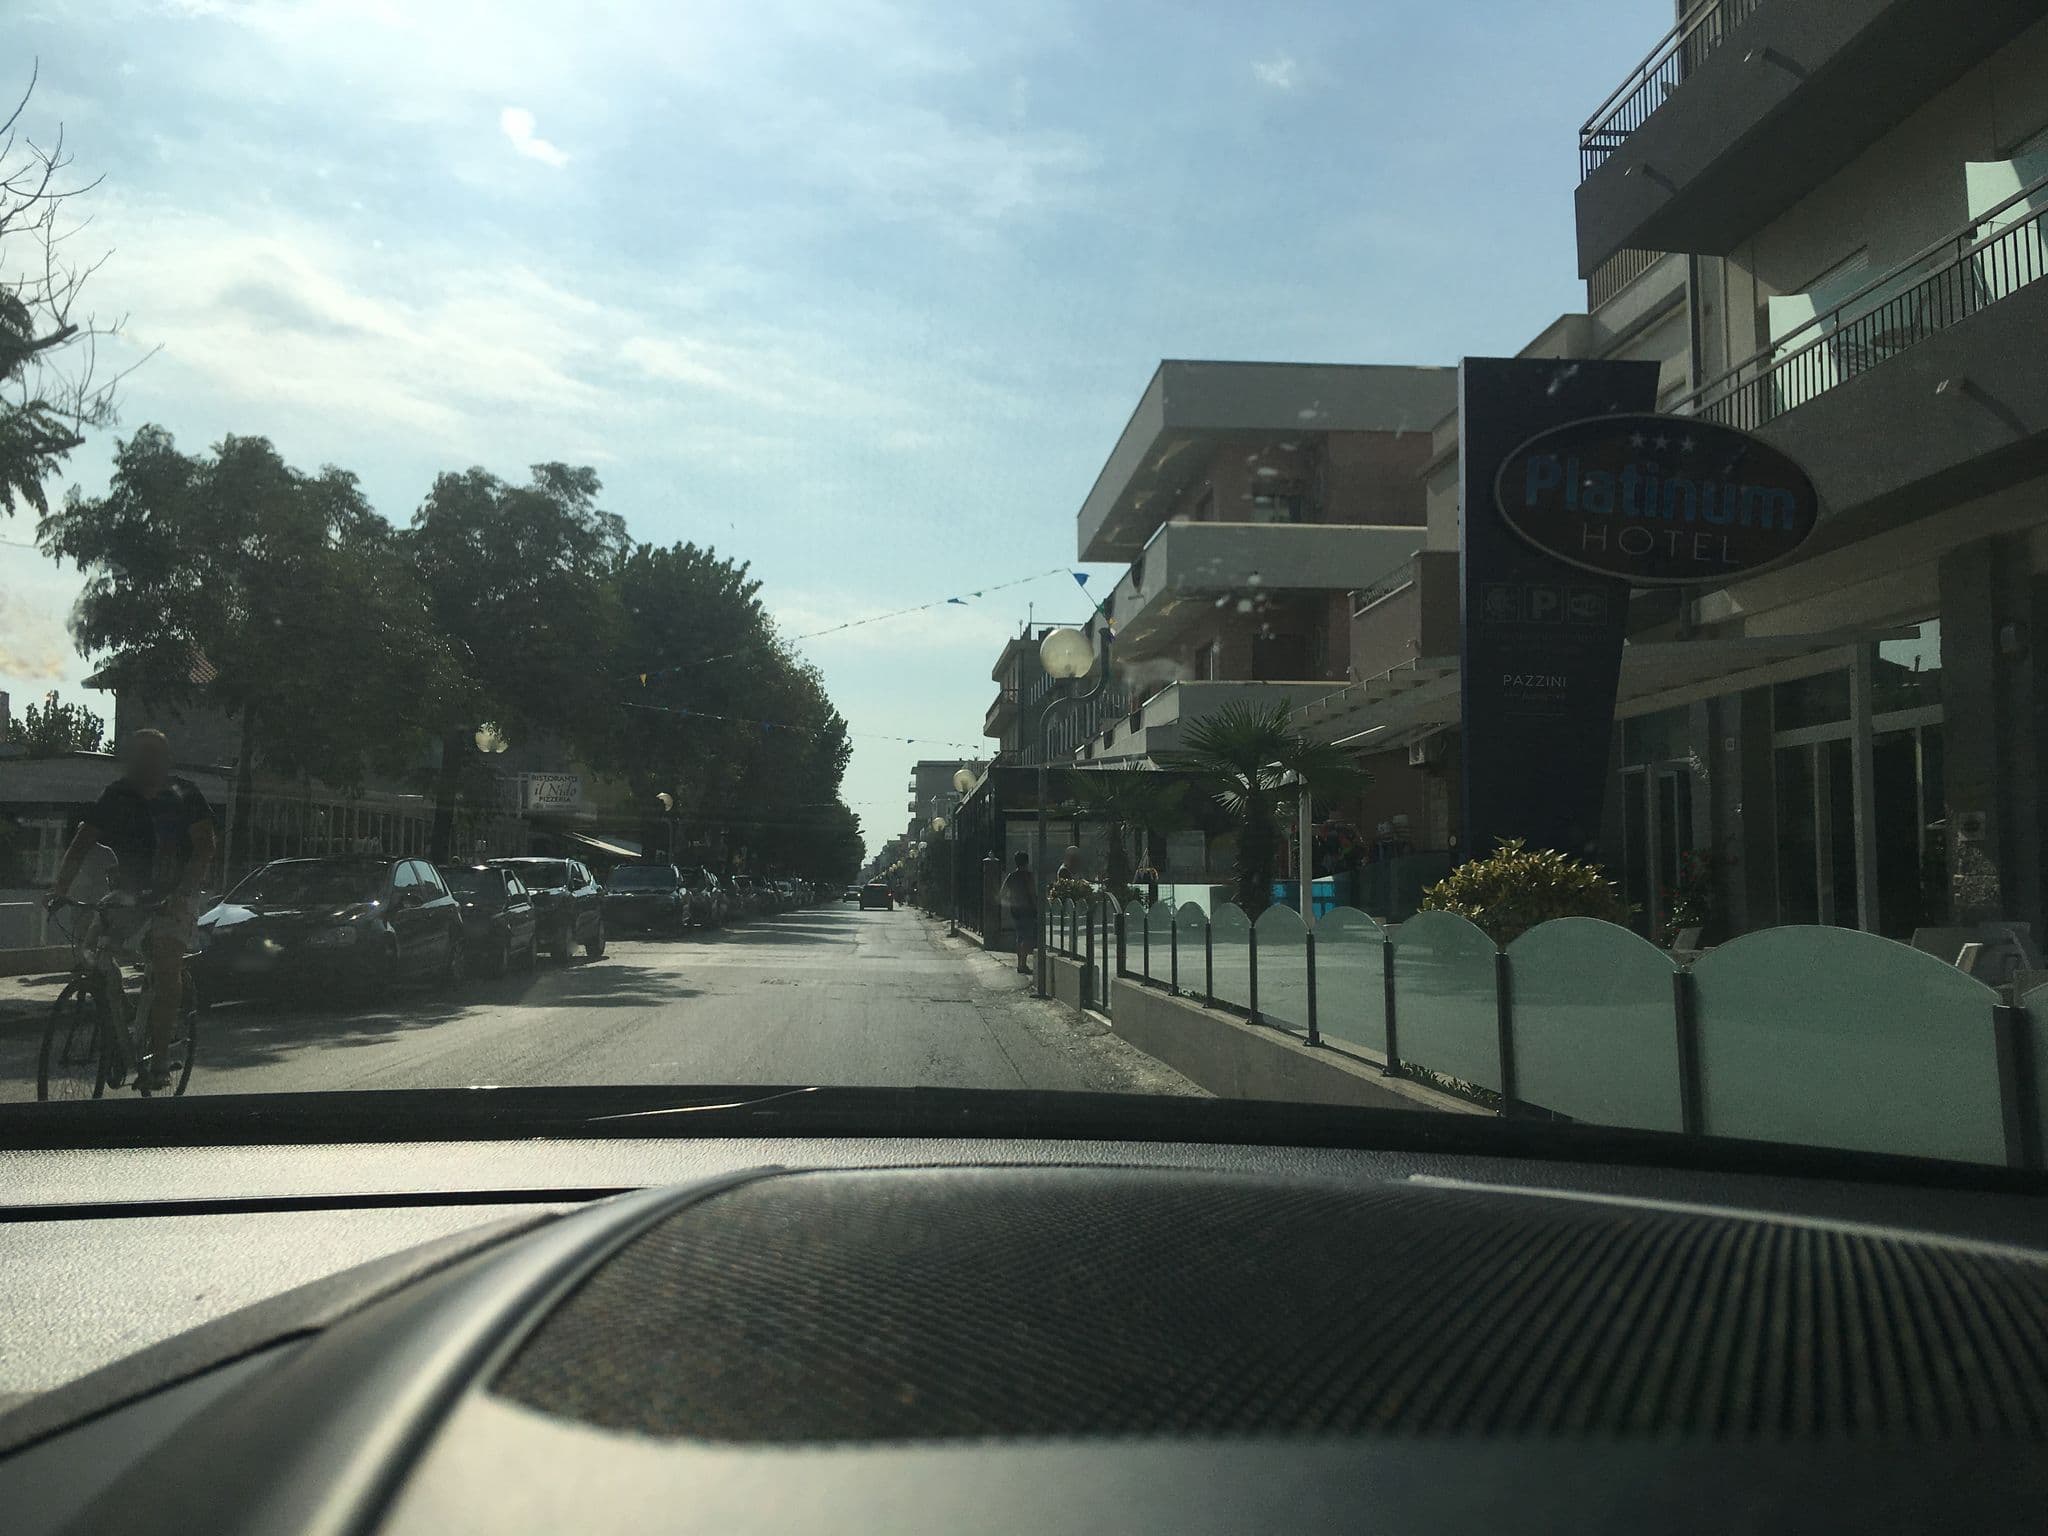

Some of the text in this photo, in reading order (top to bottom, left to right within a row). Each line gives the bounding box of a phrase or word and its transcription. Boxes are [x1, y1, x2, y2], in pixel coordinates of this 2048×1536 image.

[1525, 454, 1796, 530] Platinum
[1582, 522, 1741, 564] HOTEL
[1503, 674, 1567, 687] PAZZINI
